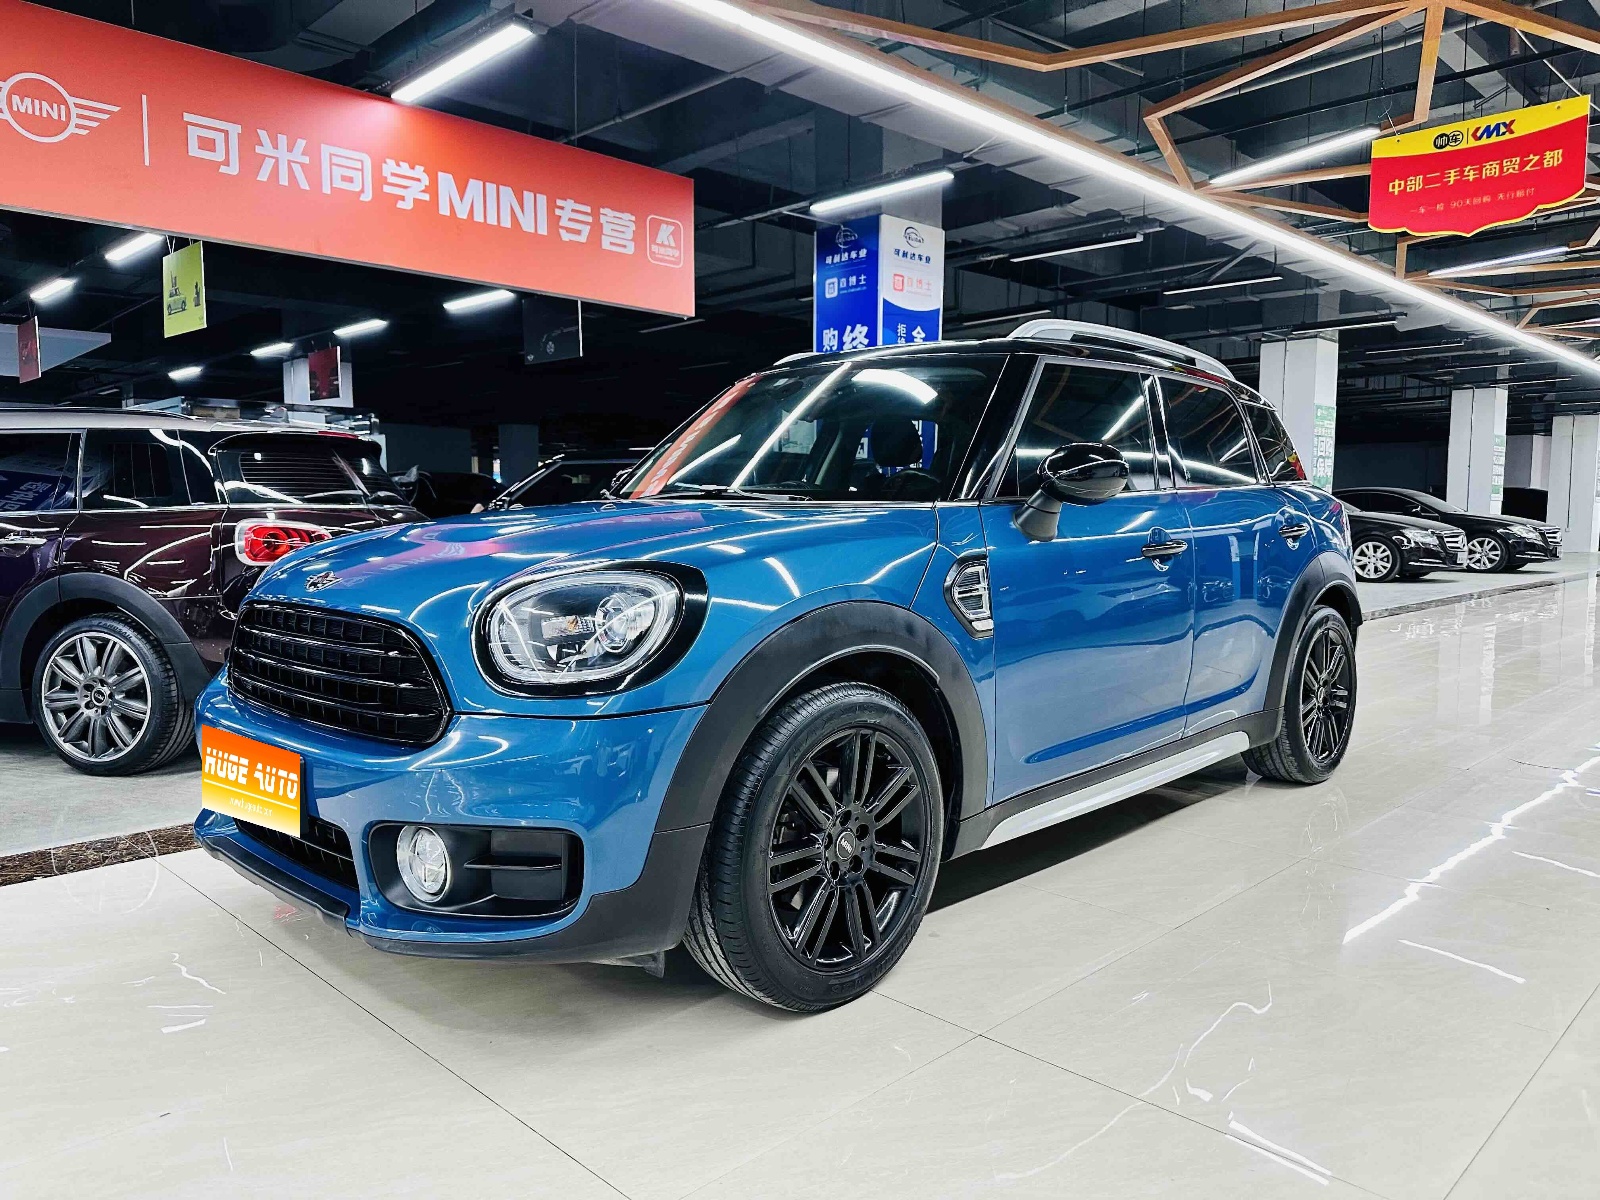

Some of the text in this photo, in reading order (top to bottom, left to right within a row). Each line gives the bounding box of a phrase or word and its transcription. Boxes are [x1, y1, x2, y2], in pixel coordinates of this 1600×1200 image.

[11, 94, 67, 123] MINI
[183, 112, 637, 255] 可米同学MINI专营
[1388, 148, 1564, 196] 中部二手车商贸之都
